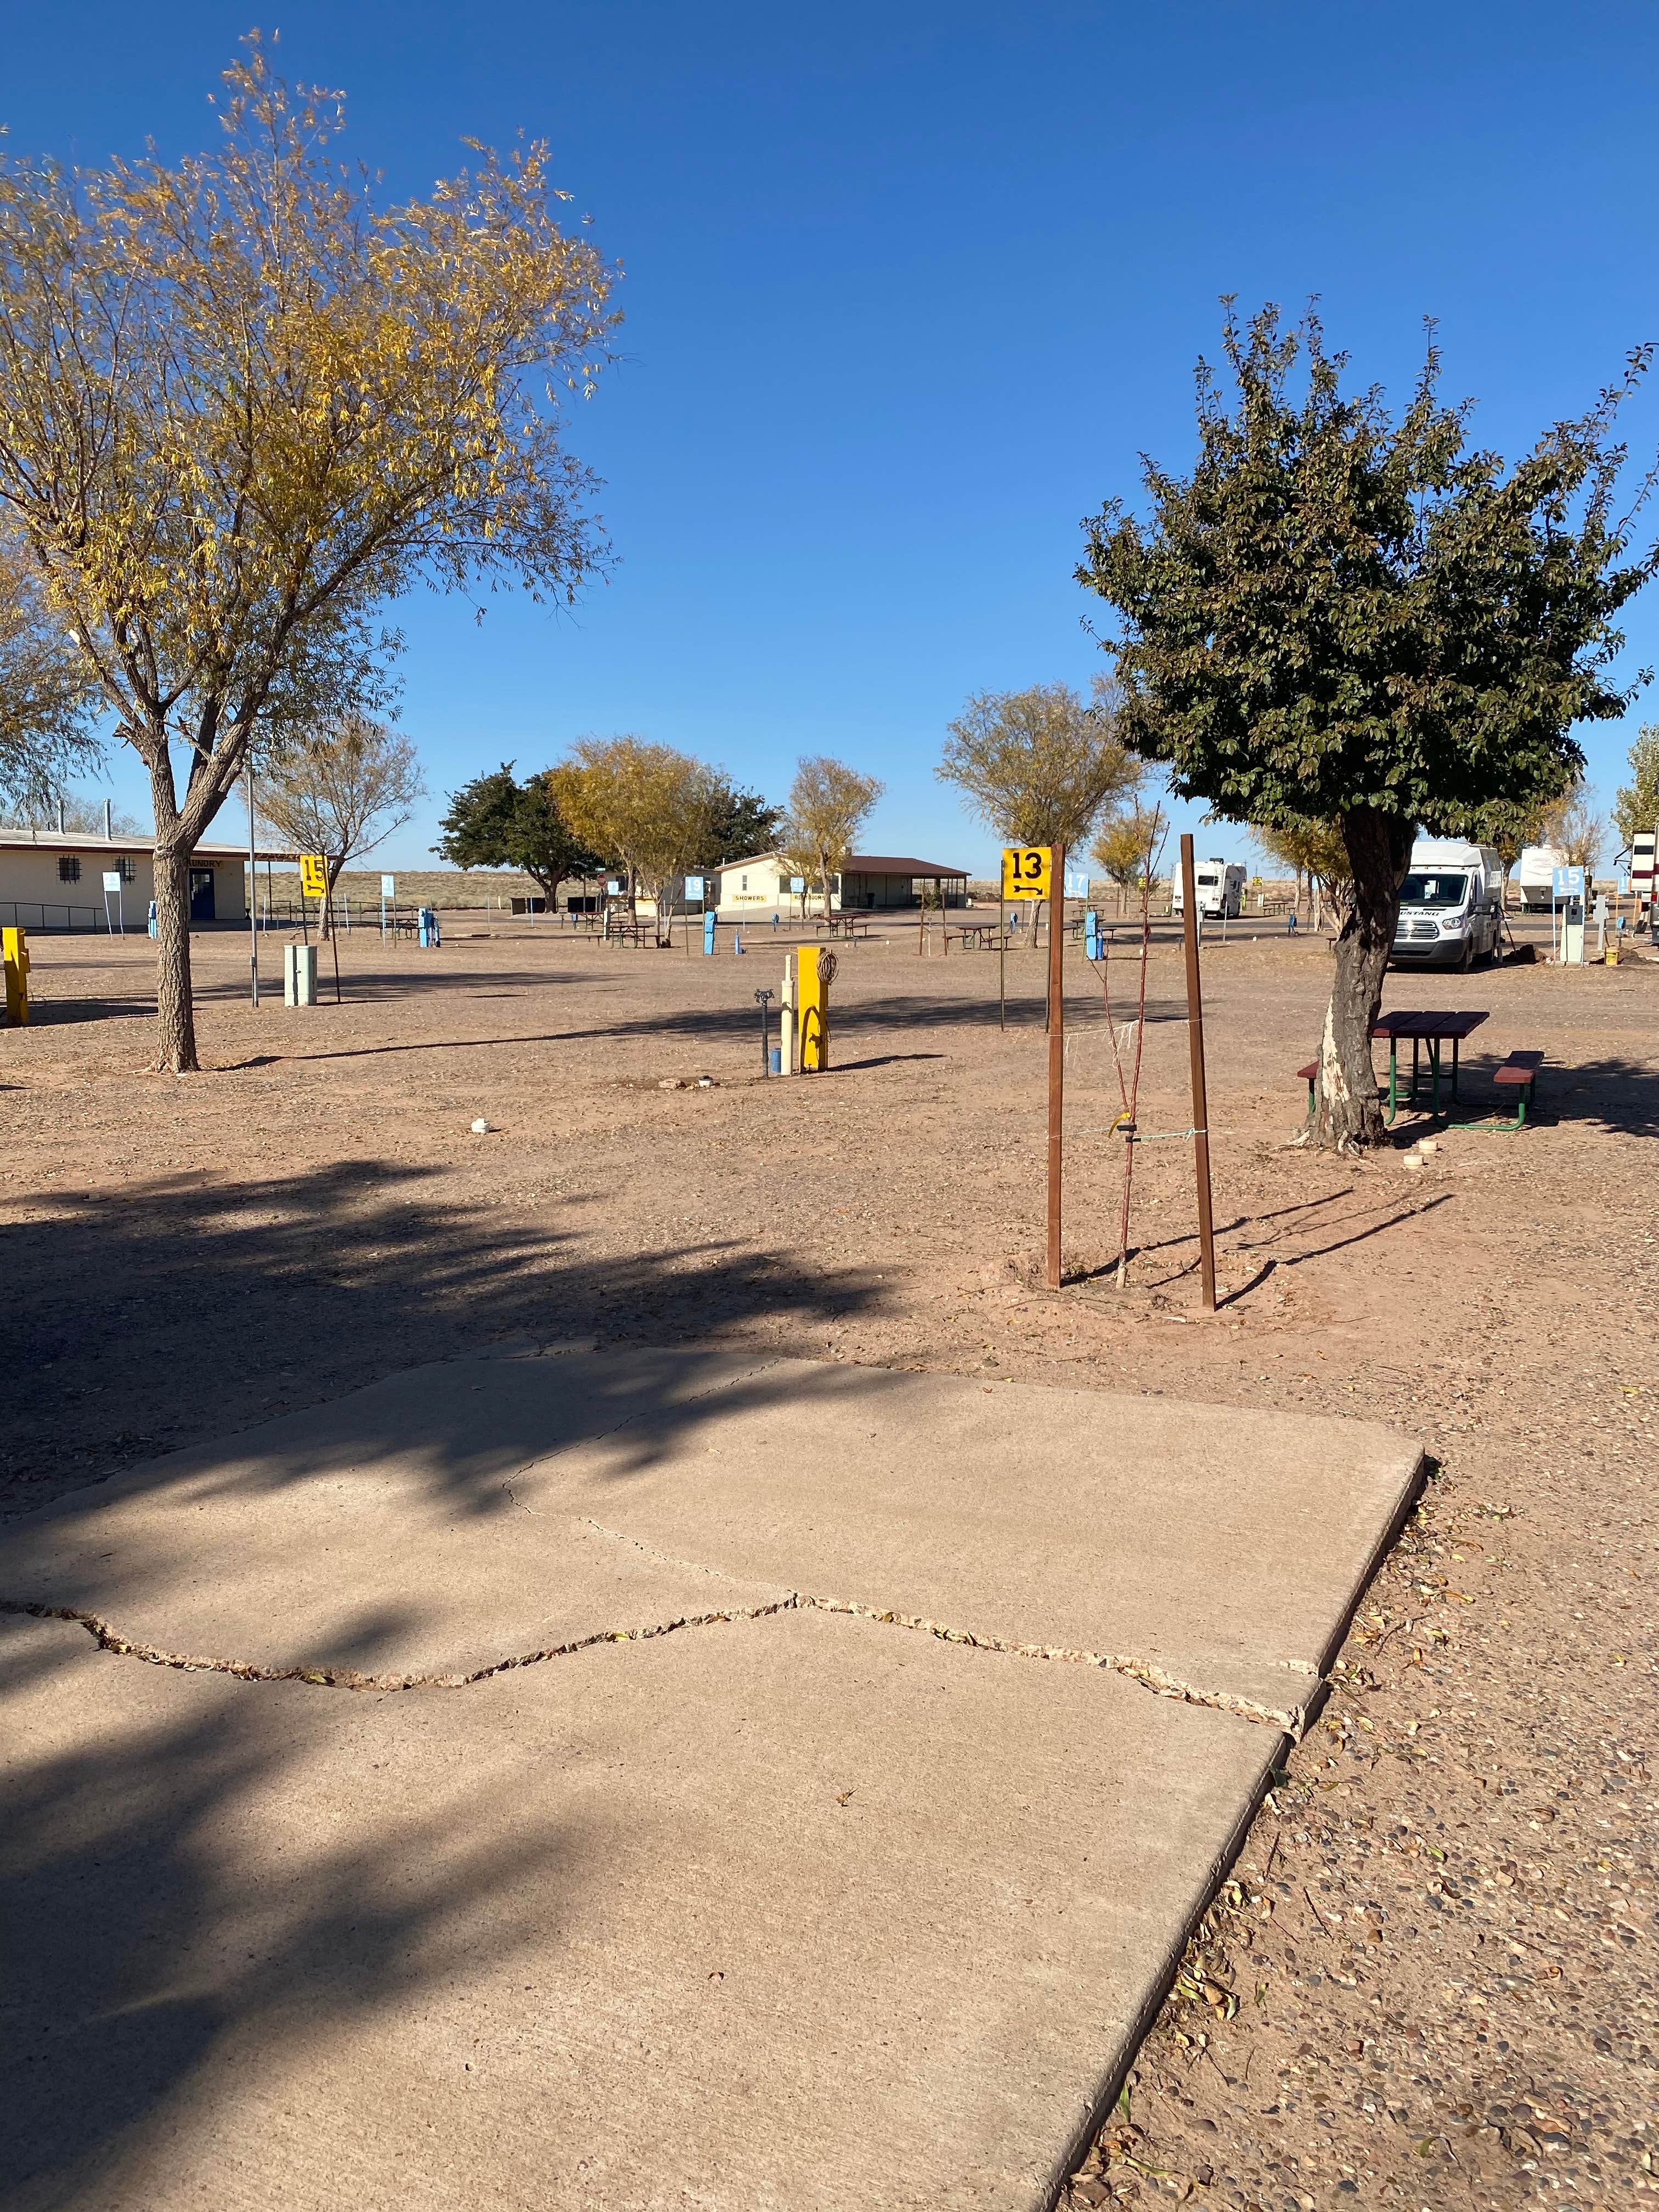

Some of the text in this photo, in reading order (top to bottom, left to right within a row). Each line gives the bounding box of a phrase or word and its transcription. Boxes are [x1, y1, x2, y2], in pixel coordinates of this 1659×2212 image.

[305, 859, 324, 881] 15
[1013, 852, 1042, 879] 13
[686, 878, 702, 891] 19
[1066, 873, 1085, 889] 17
[1558, 868, 1579, 885] 15
